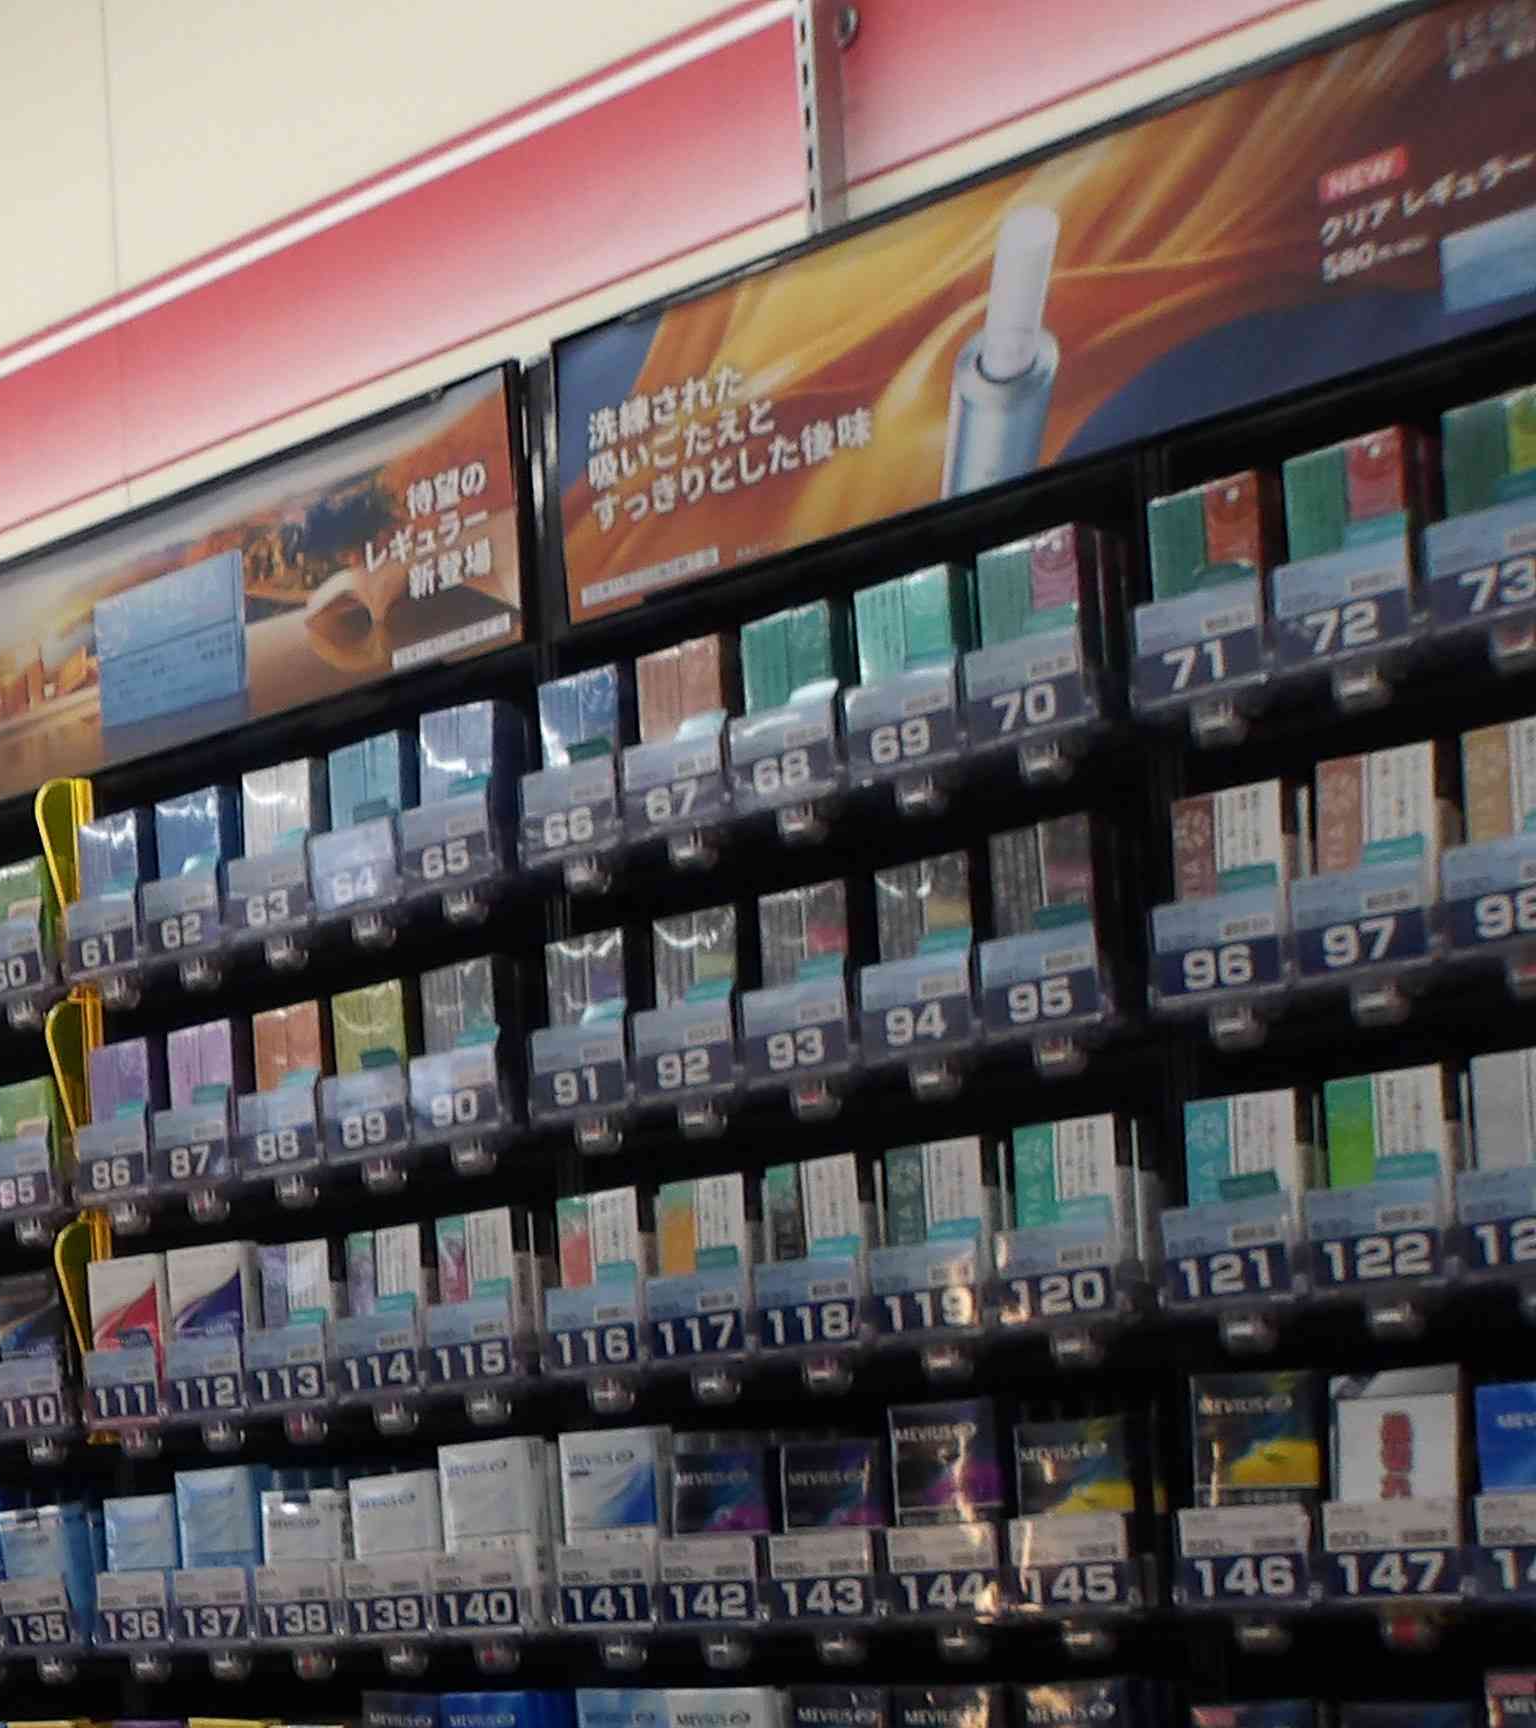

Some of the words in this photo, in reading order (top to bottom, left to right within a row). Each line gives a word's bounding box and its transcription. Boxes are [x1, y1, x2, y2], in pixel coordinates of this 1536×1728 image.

[588, 364, 744, 450] 洗練された
[588, 399, 776, 491] 吸いごたえと
[591, 406, 873, 531] すっきりとした後味
[406, 461, 487, 520] 待望の
[364, 510, 489, 574] レギュラー
[408, 536, 492, 600] 新登場
[1459, 558, 1536, 612] 73
[1305, 601, 1377, 653] 72
[1163, 639, 1226, 689] 71
[991, 683, 1056, 730] 70
[870, 724, 929, 765] 69
[753, 751, 811, 792] 68
[544, 806, 593, 845] 66
[422, 840, 469, 879] 65
[80, 934, 117, 966] 61
[161, 914, 202, 946] 62
[1322, 918, 1398, 967] 97
[1182, 944, 1255, 990] 96
[1008, 977, 1072, 1020] 95
[885, 1002, 946, 1044] 94
[655, 1048, 711, 1088] 92
[767, 1027, 824, 1069] 93
[553, 1068, 600, 1104] 91
[432, 1091, 479, 1127] 90
[257, 1129, 299, 1160] 88
[342, 1113, 387, 1147] 89
[91, 1160, 129, 1190] 86
[170, 1144, 212, 1177] 87
[1179, 1247, 1273, 1298] 121
[1324, 1232, 1432, 1283] 122
[884, 1288, 974, 1332] 119
[1012, 1270, 1105, 1318] 120
[658, 1310, 735, 1355] 117
[767, 1302, 850, 1345] 118
[435, 1339, 505, 1380] 115
[555, 1326, 629, 1368] 116
[255, 1367, 319, 1400] 113
[345, 1351, 412, 1387] 114
[3, 1394, 55, 1427] 110
[95, 1384, 147, 1419] 111
[176, 1377, 235, 1411] 112
[1194, 1556, 1295, 1596] 146
[1338, 1550, 1446, 1593] 147
[351, 1596, 420, 1631] 139
[437, 1590, 511, 1629] 140
[568, 1586, 637, 1622] 141
[668, 1583, 747, 1619] 142
[782, 1577, 864, 1616] 143
[10, 1613, 65, 1646] 135
[103, 1608, 160, 1641] 136
[183, 1605, 241, 1638] 137
[264, 1601, 327, 1635] 138
